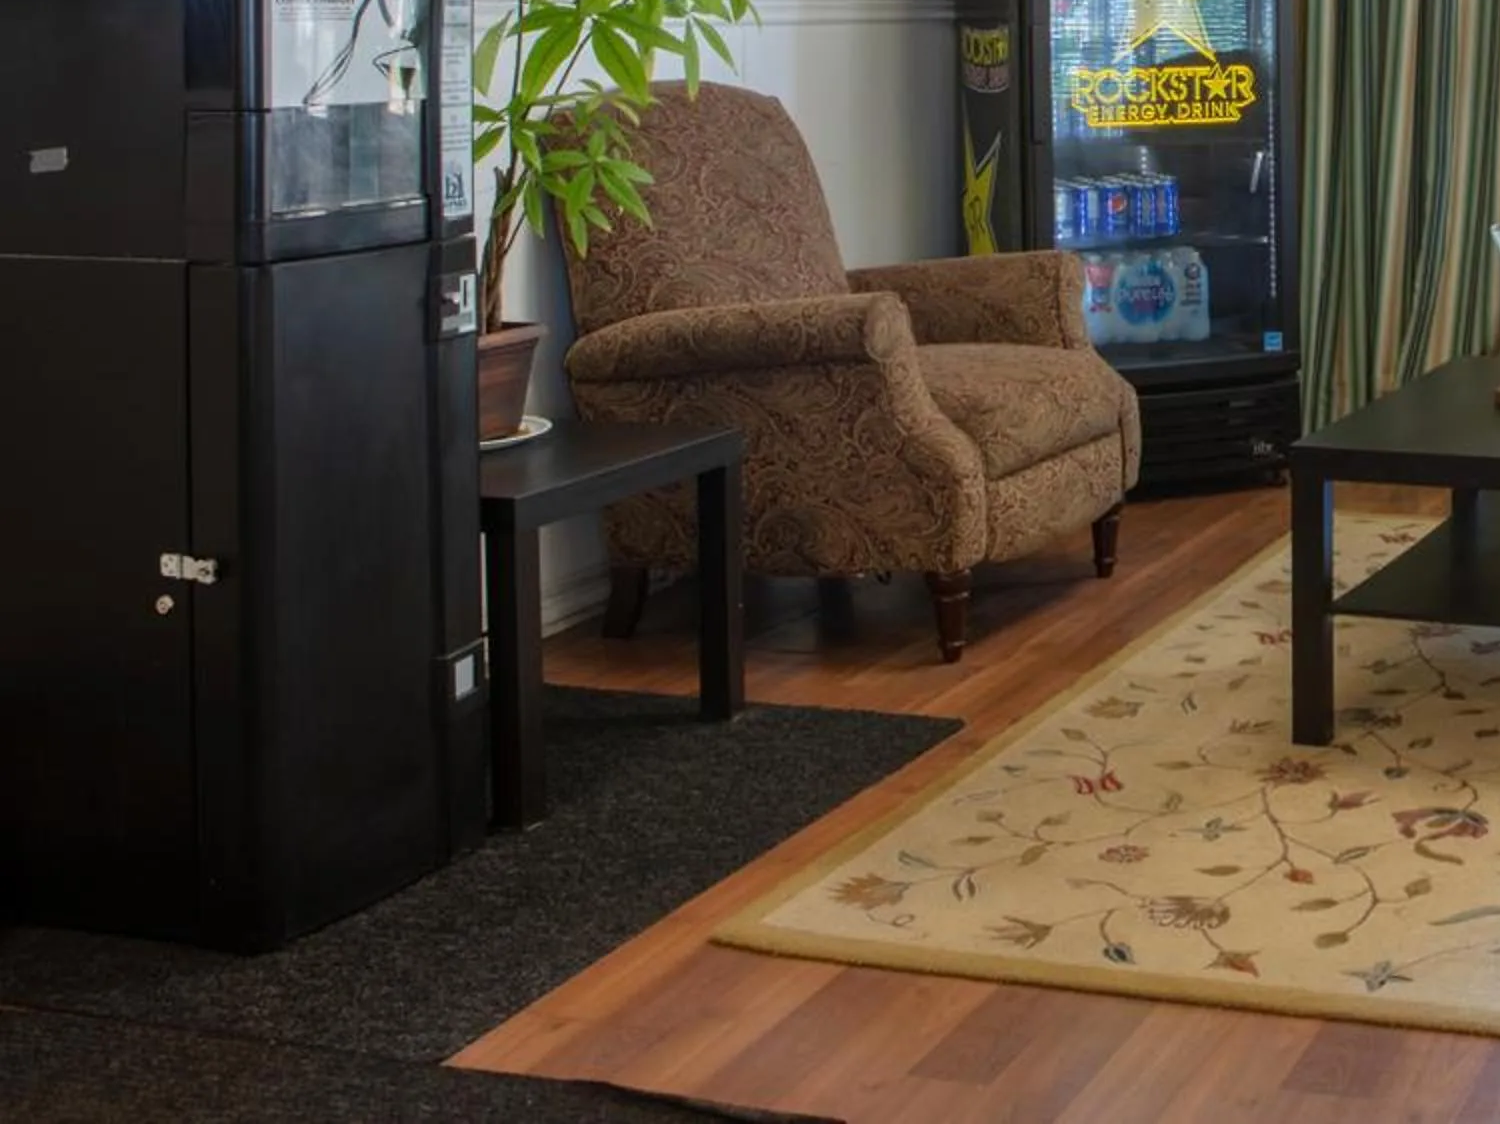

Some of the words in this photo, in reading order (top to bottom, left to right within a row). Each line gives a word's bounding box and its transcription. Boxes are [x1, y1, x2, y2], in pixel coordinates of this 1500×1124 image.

[1074, 64, 1254, 104] ROCKSTAR
[1089, 104, 1168, 123] ENERGY
[1177, 102, 1237, 119] DRINK
